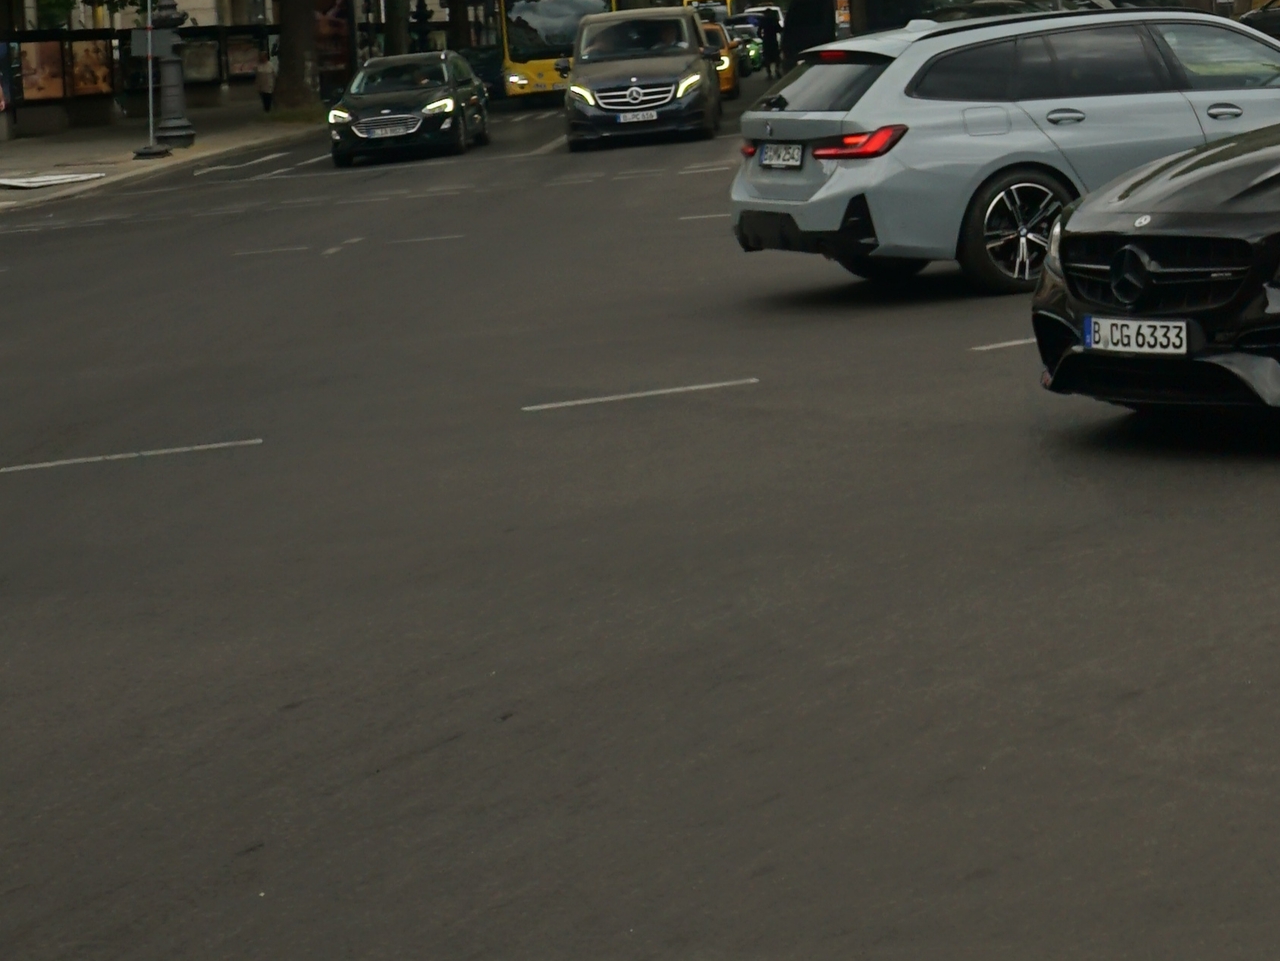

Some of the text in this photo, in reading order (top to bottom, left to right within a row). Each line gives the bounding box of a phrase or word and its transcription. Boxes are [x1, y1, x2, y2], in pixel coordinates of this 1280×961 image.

[1092, 321, 1183, 349] B CG 6333
